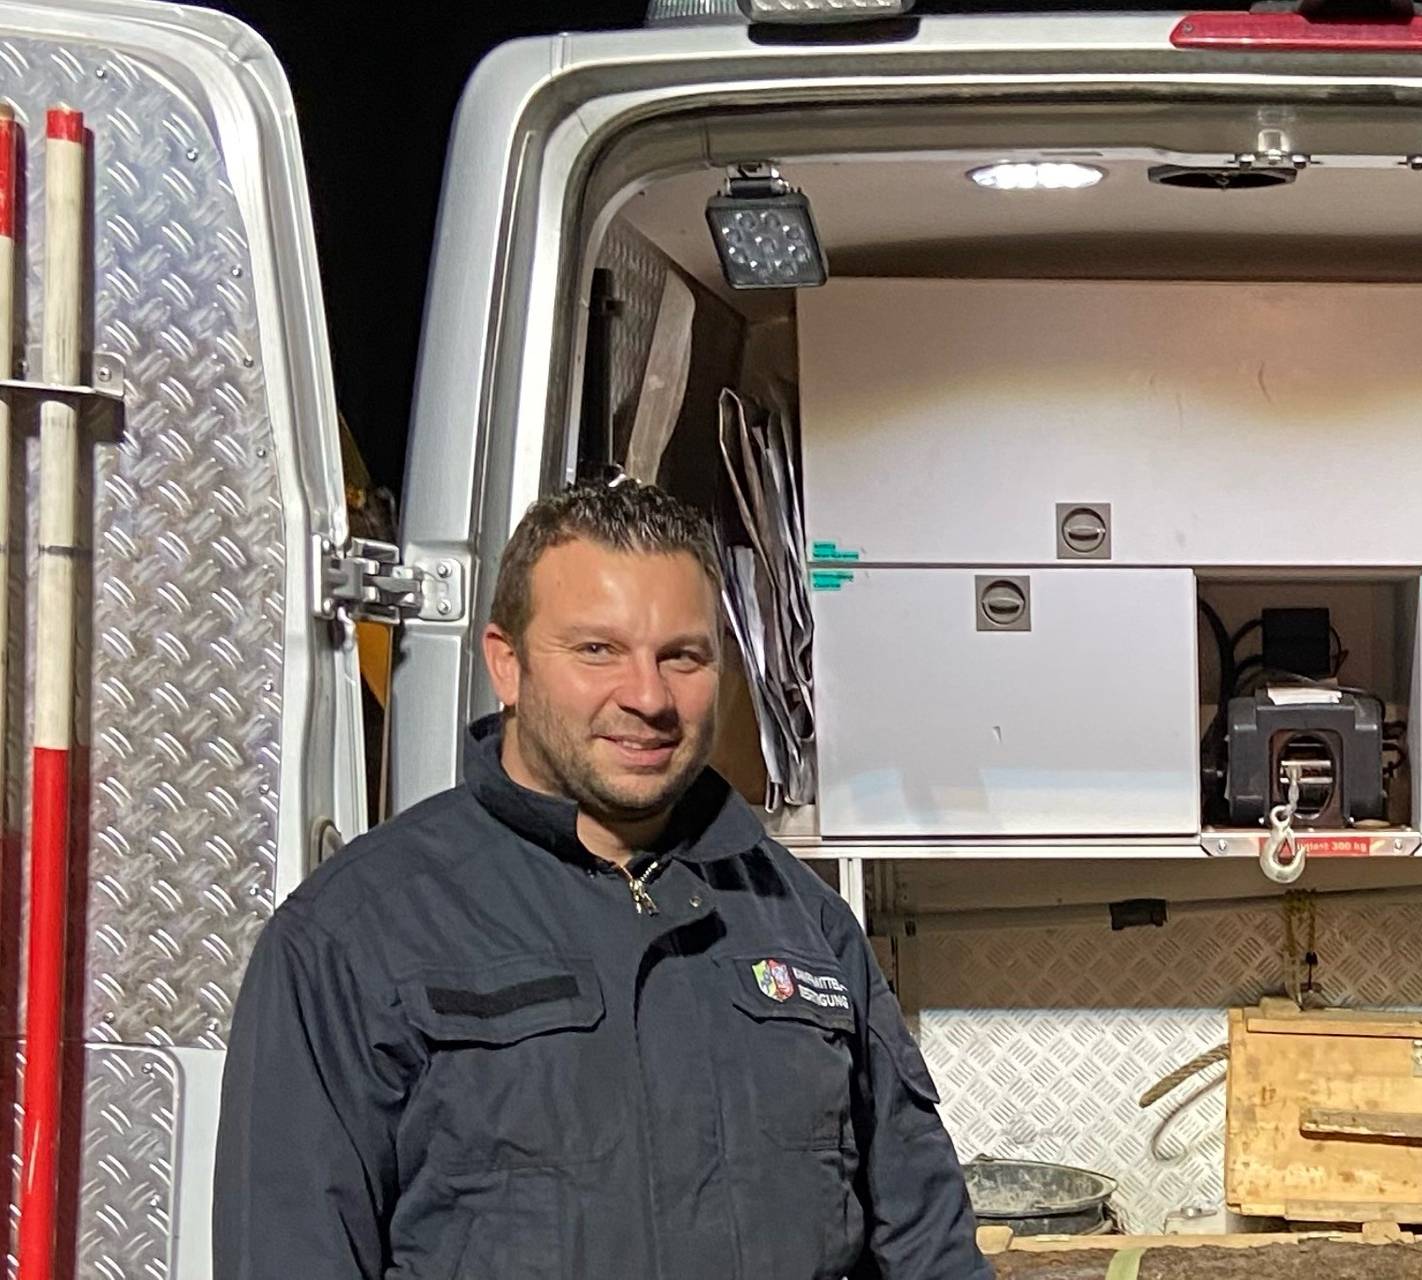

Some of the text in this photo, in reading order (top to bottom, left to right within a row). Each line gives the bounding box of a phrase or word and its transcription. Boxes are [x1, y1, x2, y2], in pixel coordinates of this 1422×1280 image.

[1331, 841, 1351, 851] 300
[1354, 841, 1367, 853] kg
[791, 966, 849, 991] MITTEL-
